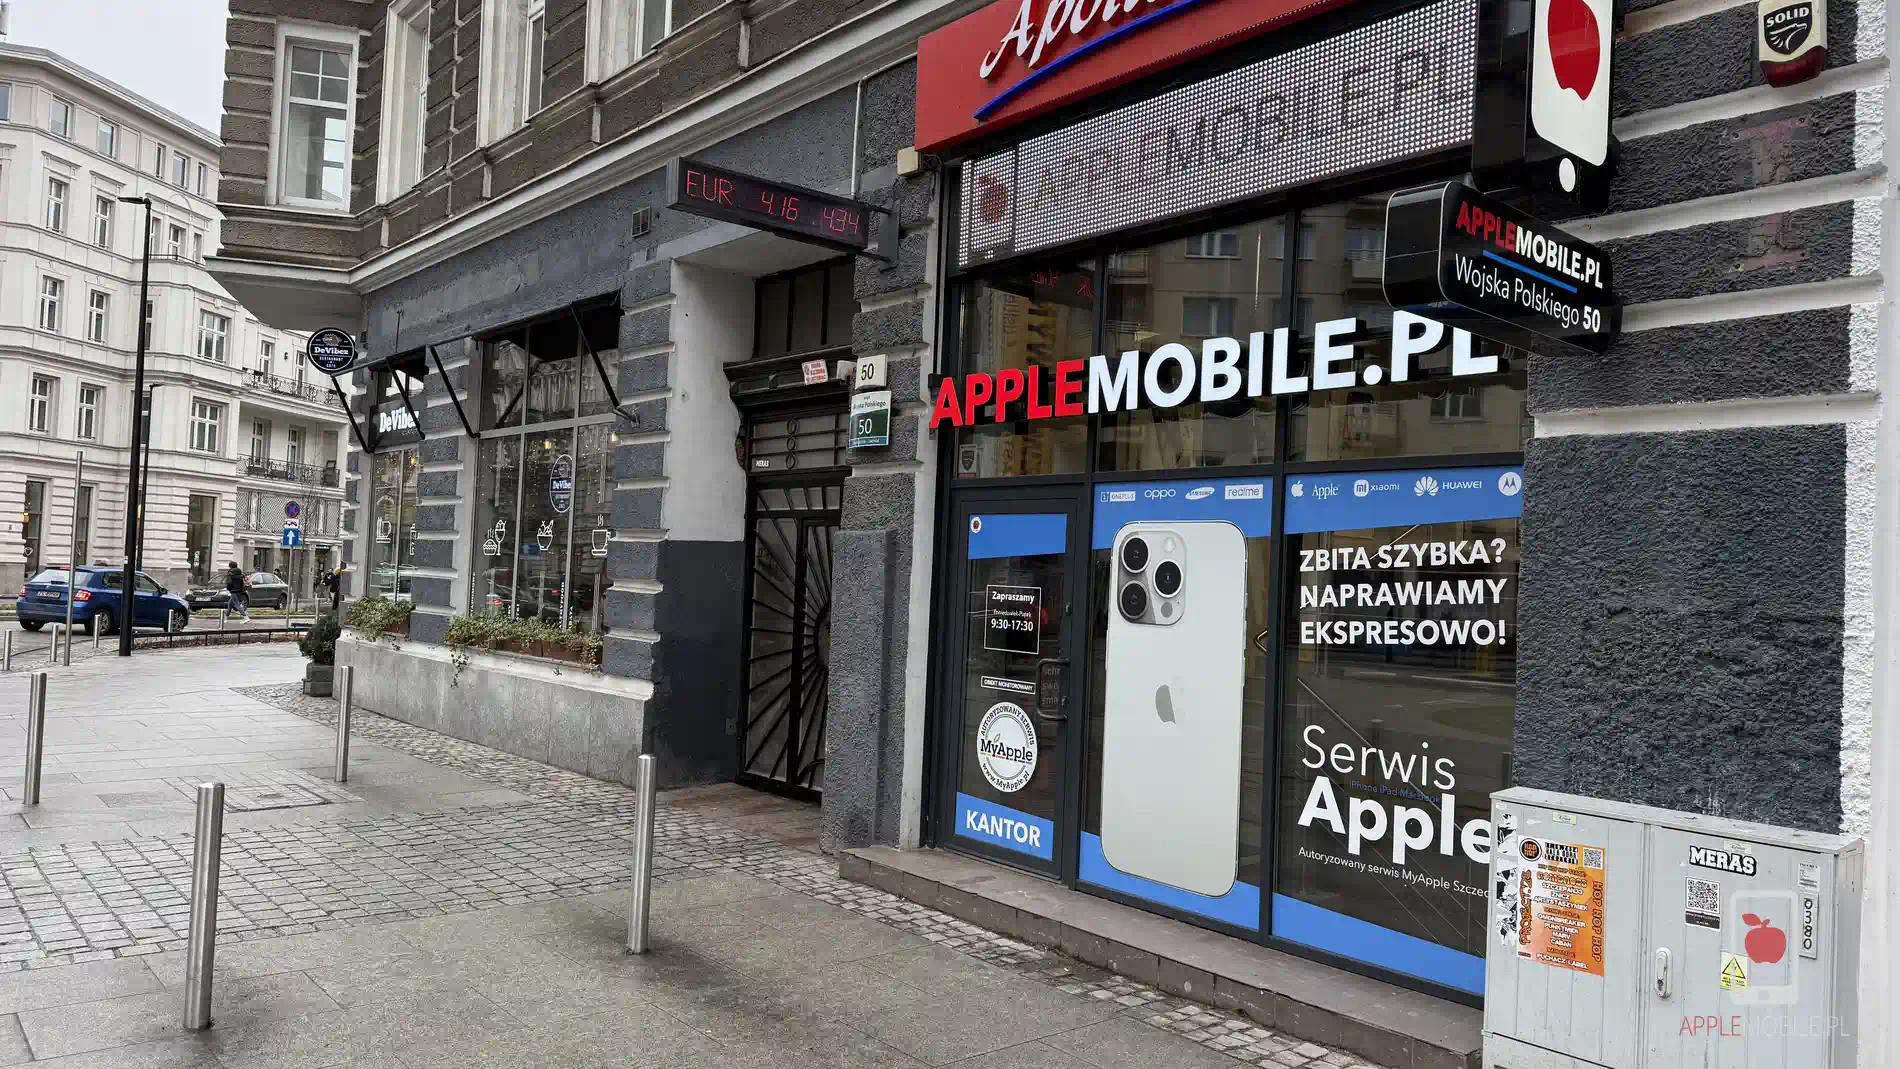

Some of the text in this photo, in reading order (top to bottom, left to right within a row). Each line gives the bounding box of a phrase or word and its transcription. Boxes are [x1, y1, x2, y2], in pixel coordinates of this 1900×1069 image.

[1766, 7, 1810, 28] SOLID
[686, 169, 733, 206] EUR
[1455, 200, 1604, 290] APPLEMOBILE.PL
[1455, 252, 1601, 333] Wojska Polskiego 50
[861, 363, 875, 381] 50
[927, 310, 1499, 430] APPLEMOBILE.PL
[858, 418, 873, 435] 50
[552, 479, 572, 490] DeVibe
[1227, 486, 1260, 497] realme
[1312, 482, 1340, 500] Apple
[1442, 480, 1482, 491] HUAWEI
[1300, 537, 1507, 573] ZBITA SZYBKA?
[991, 591, 1035, 604] Zapraszamy
[1300, 578, 1508, 609] NAPRAWIAMY
[990, 618, 1034, 632] 9:30-17:30
[1301, 619, 1507, 646] EKSPRESOWO!
[981, 705, 1035, 746] AUTORYZOWANY SERWIS
[980, 738, 1033, 762] MyApple
[1302, 724, 1456, 790] Serwis
[966, 809, 1041, 848] KANTOR
[1297, 775, 1491, 866] Apple
[1298, 846, 1490, 899] Autoryzowany serwis MyApple Szczec
[1690, 846, 1757, 875] MERAS
